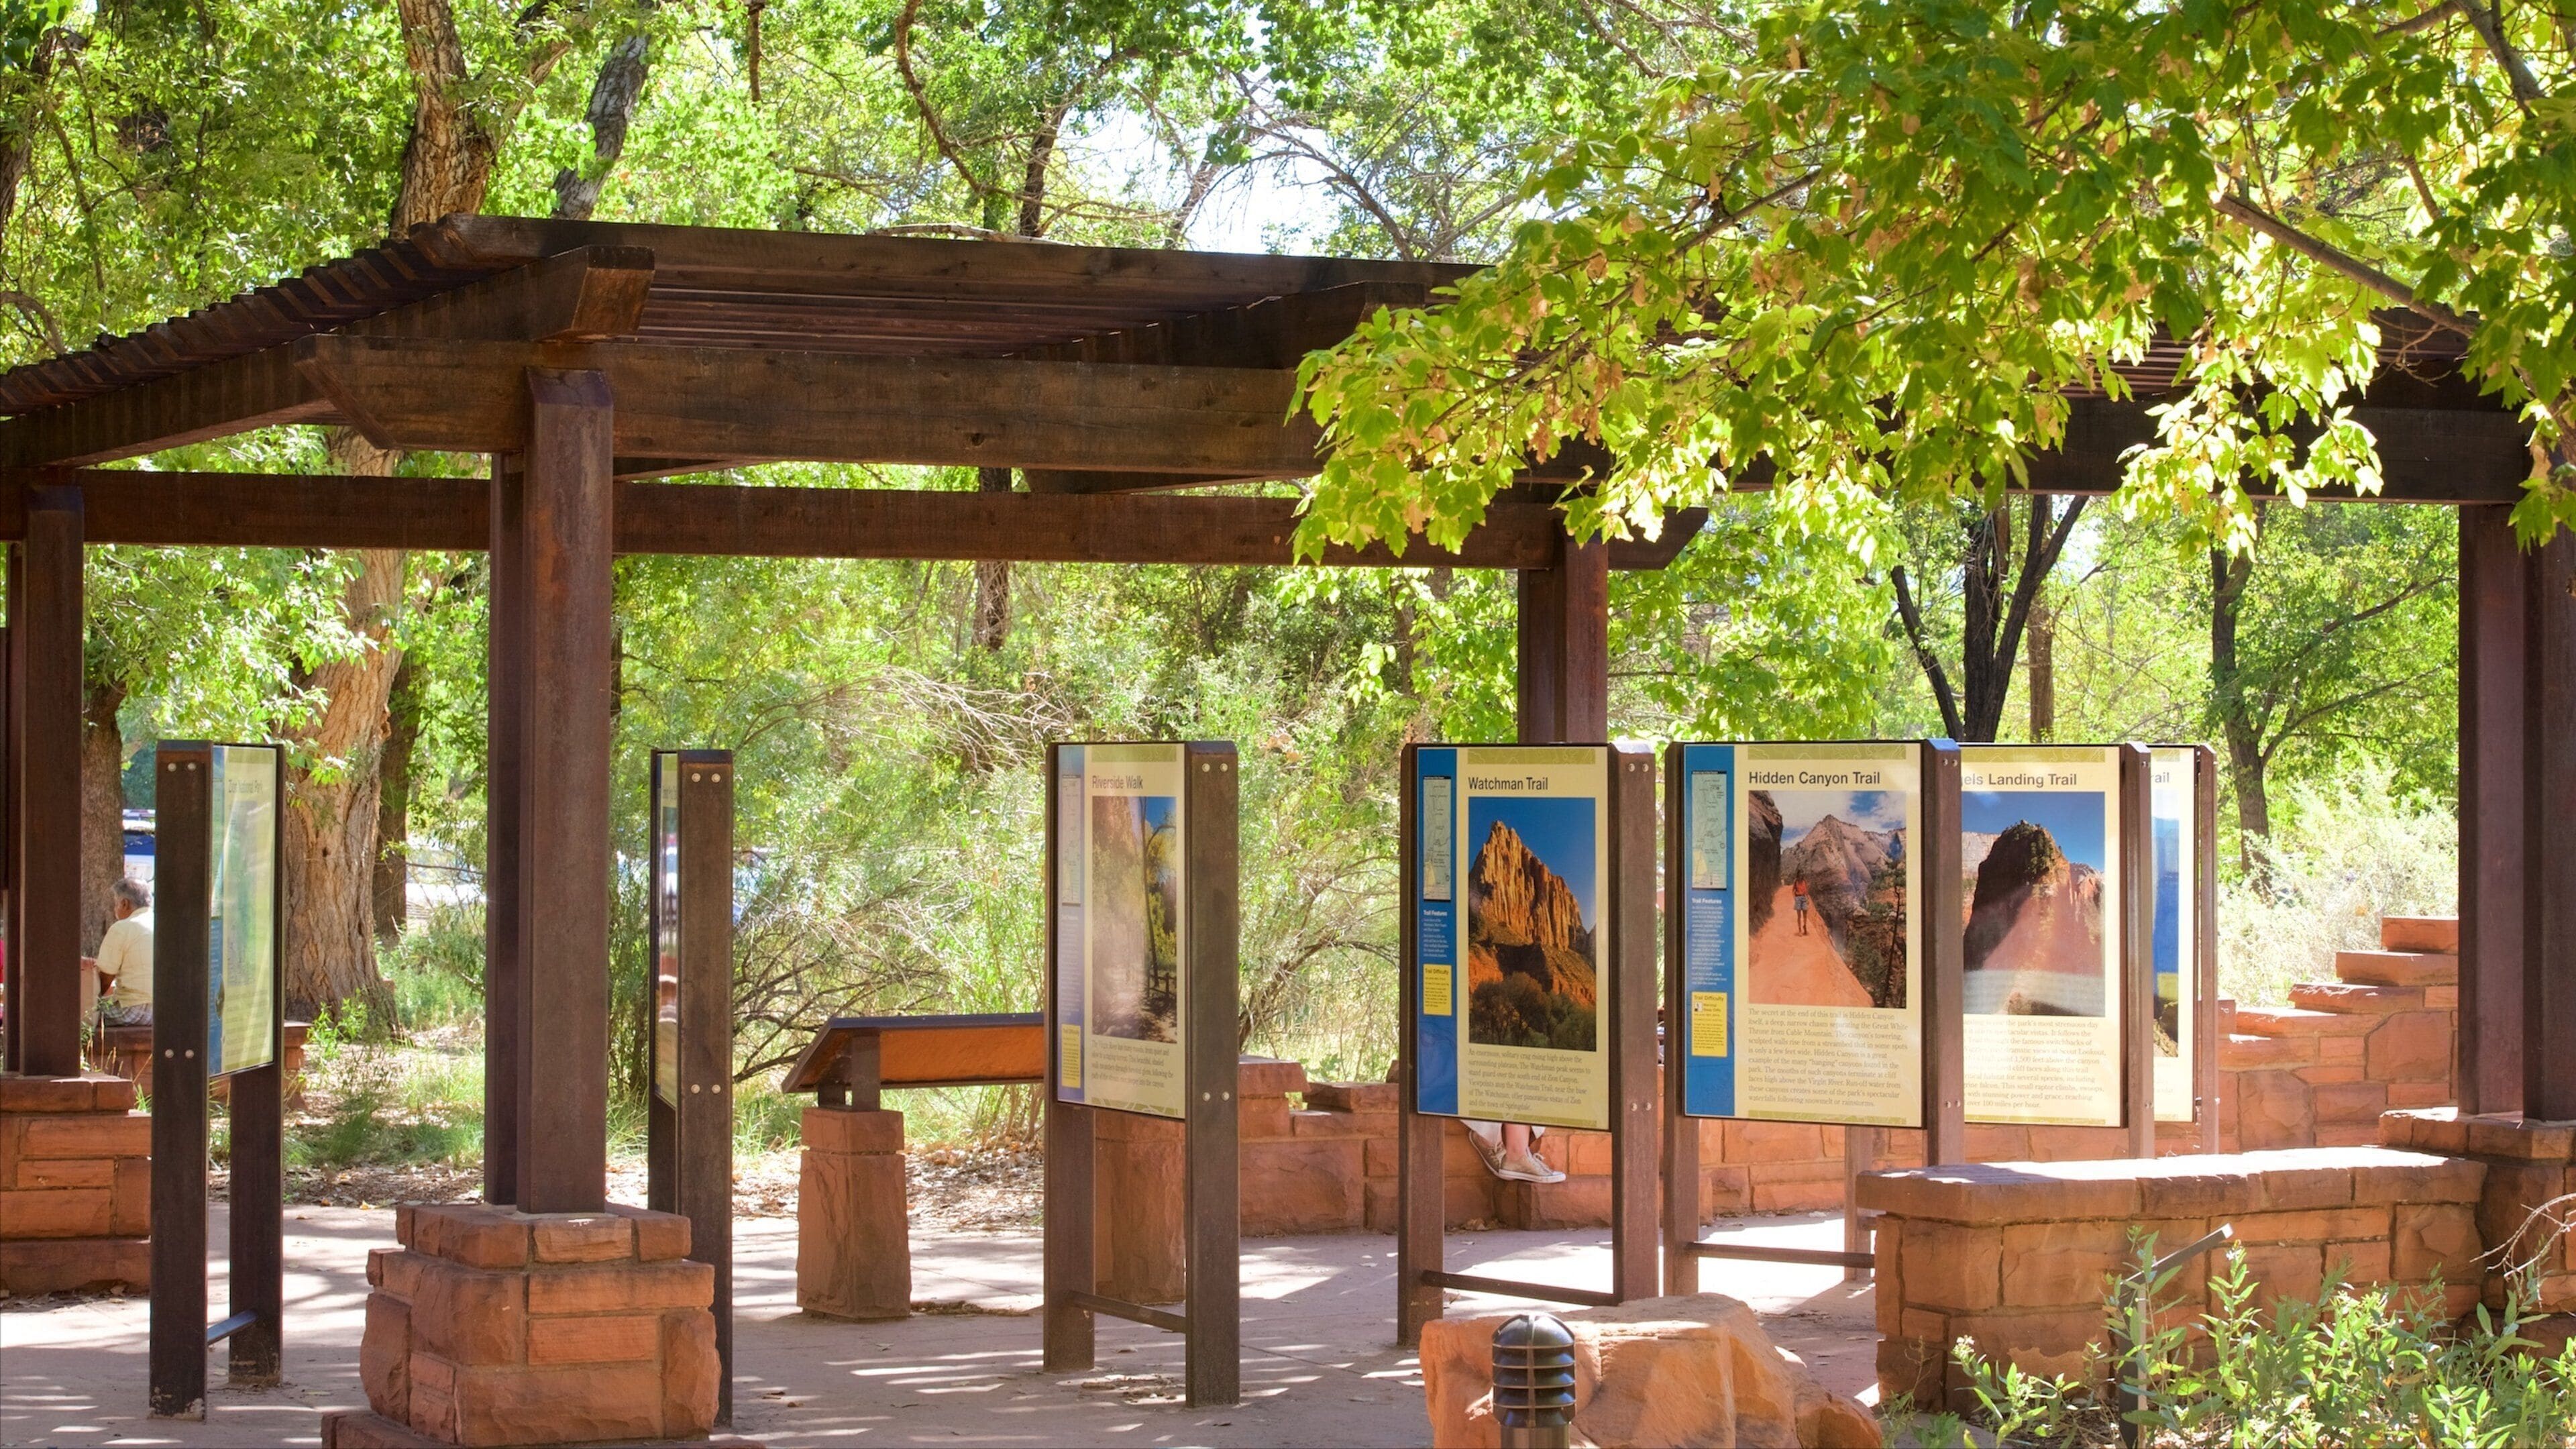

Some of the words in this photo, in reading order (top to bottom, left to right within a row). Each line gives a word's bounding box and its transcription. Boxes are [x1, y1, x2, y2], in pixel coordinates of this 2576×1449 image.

[1091, 775, 1124, 789] Riverside
[1126, 775, 1143, 789] Walk
[1468, 777, 1523, 790] Watchman
[1525, 777, 1548, 790] Trail
[1749, 771, 1794, 784] Hidden
[1799, 771, 1848, 787] Canyon
[1853, 771, 1880, 784] Trail
[1961, 773, 1984, 787] els
[1988, 773, 2044, 788] Landing
[2048, 773, 2077, 786] Trail
[2151, 772, 2169, 783] ail
[1872, 1012, 1894, 1021] Canyon
